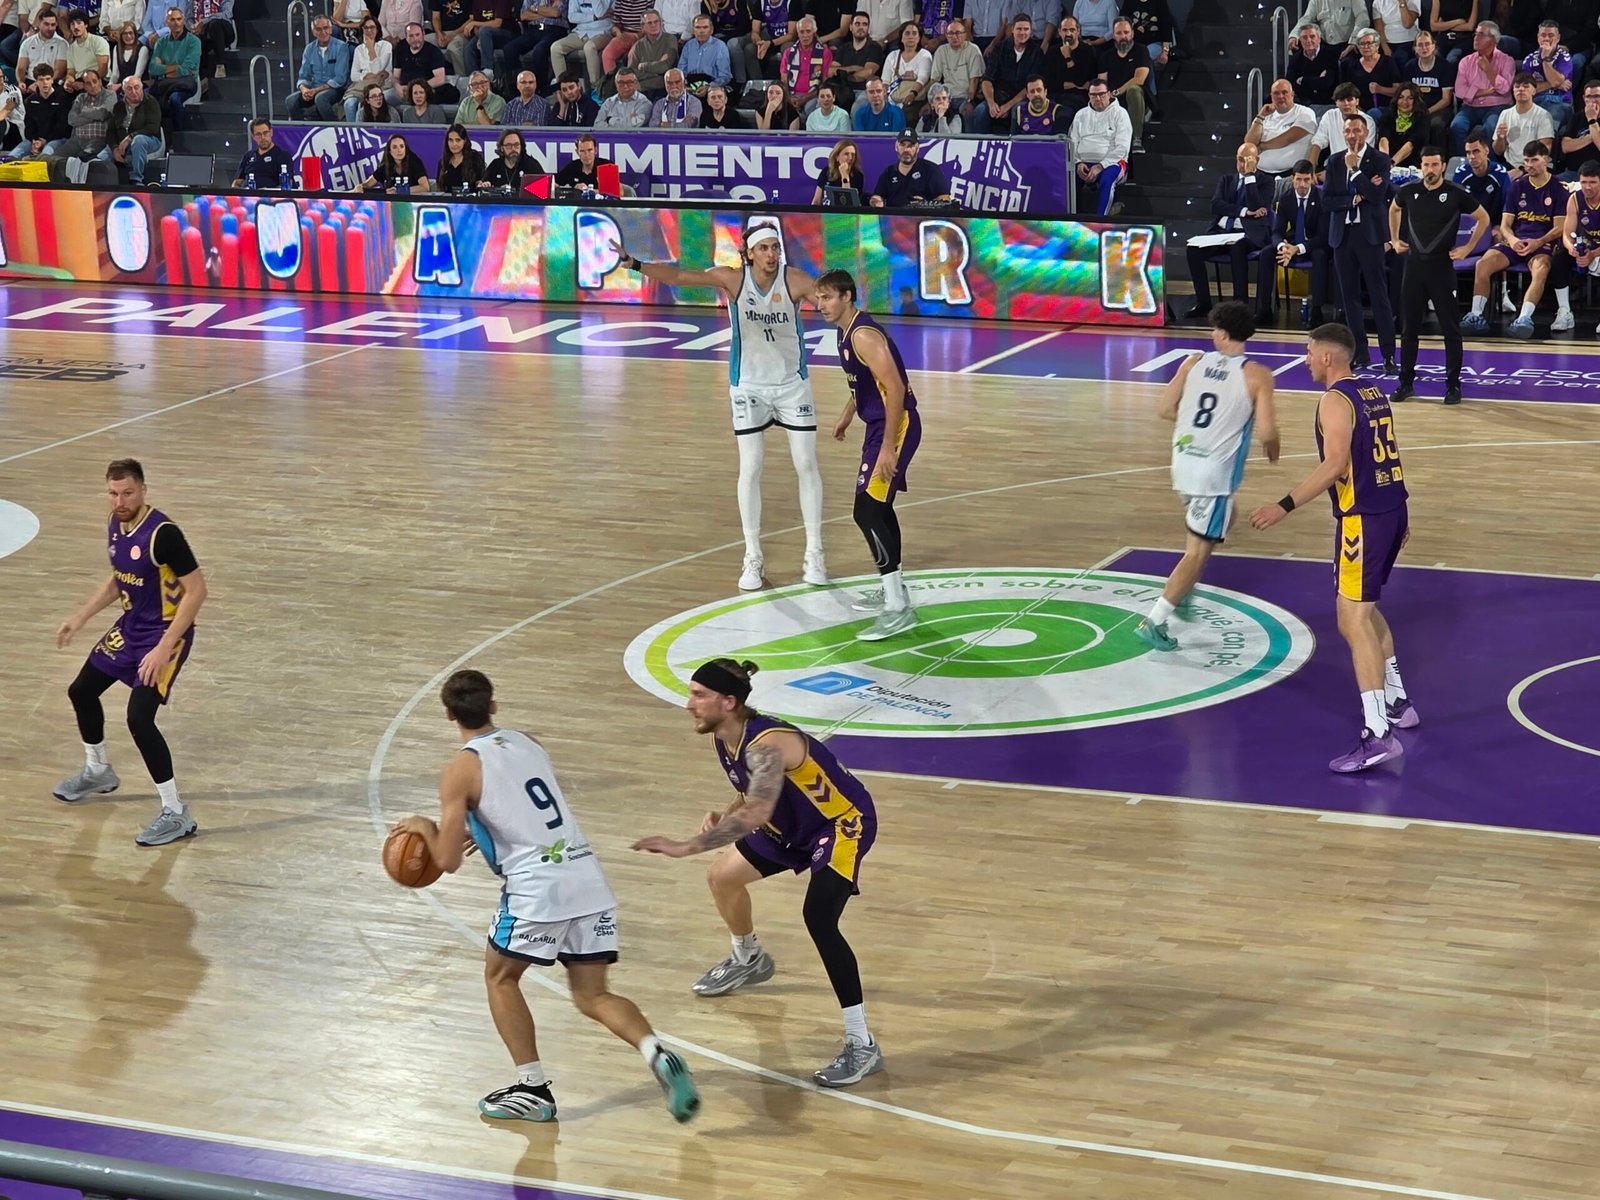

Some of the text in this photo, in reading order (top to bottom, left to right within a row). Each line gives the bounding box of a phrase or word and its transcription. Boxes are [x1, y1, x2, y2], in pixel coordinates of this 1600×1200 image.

[763, 328, 776, 342] 11
[1193, 392, 1218, 429] 8
[1369, 416, 1399, 463] 33
[1000, 579, 1103, 592] sobre
[1221, 631, 1246, 649] con
[846, 691, 953, 719] DE PALENCIA
[865, 685, 952, 709] Diputación
[525, 777, 564, 830] 9
